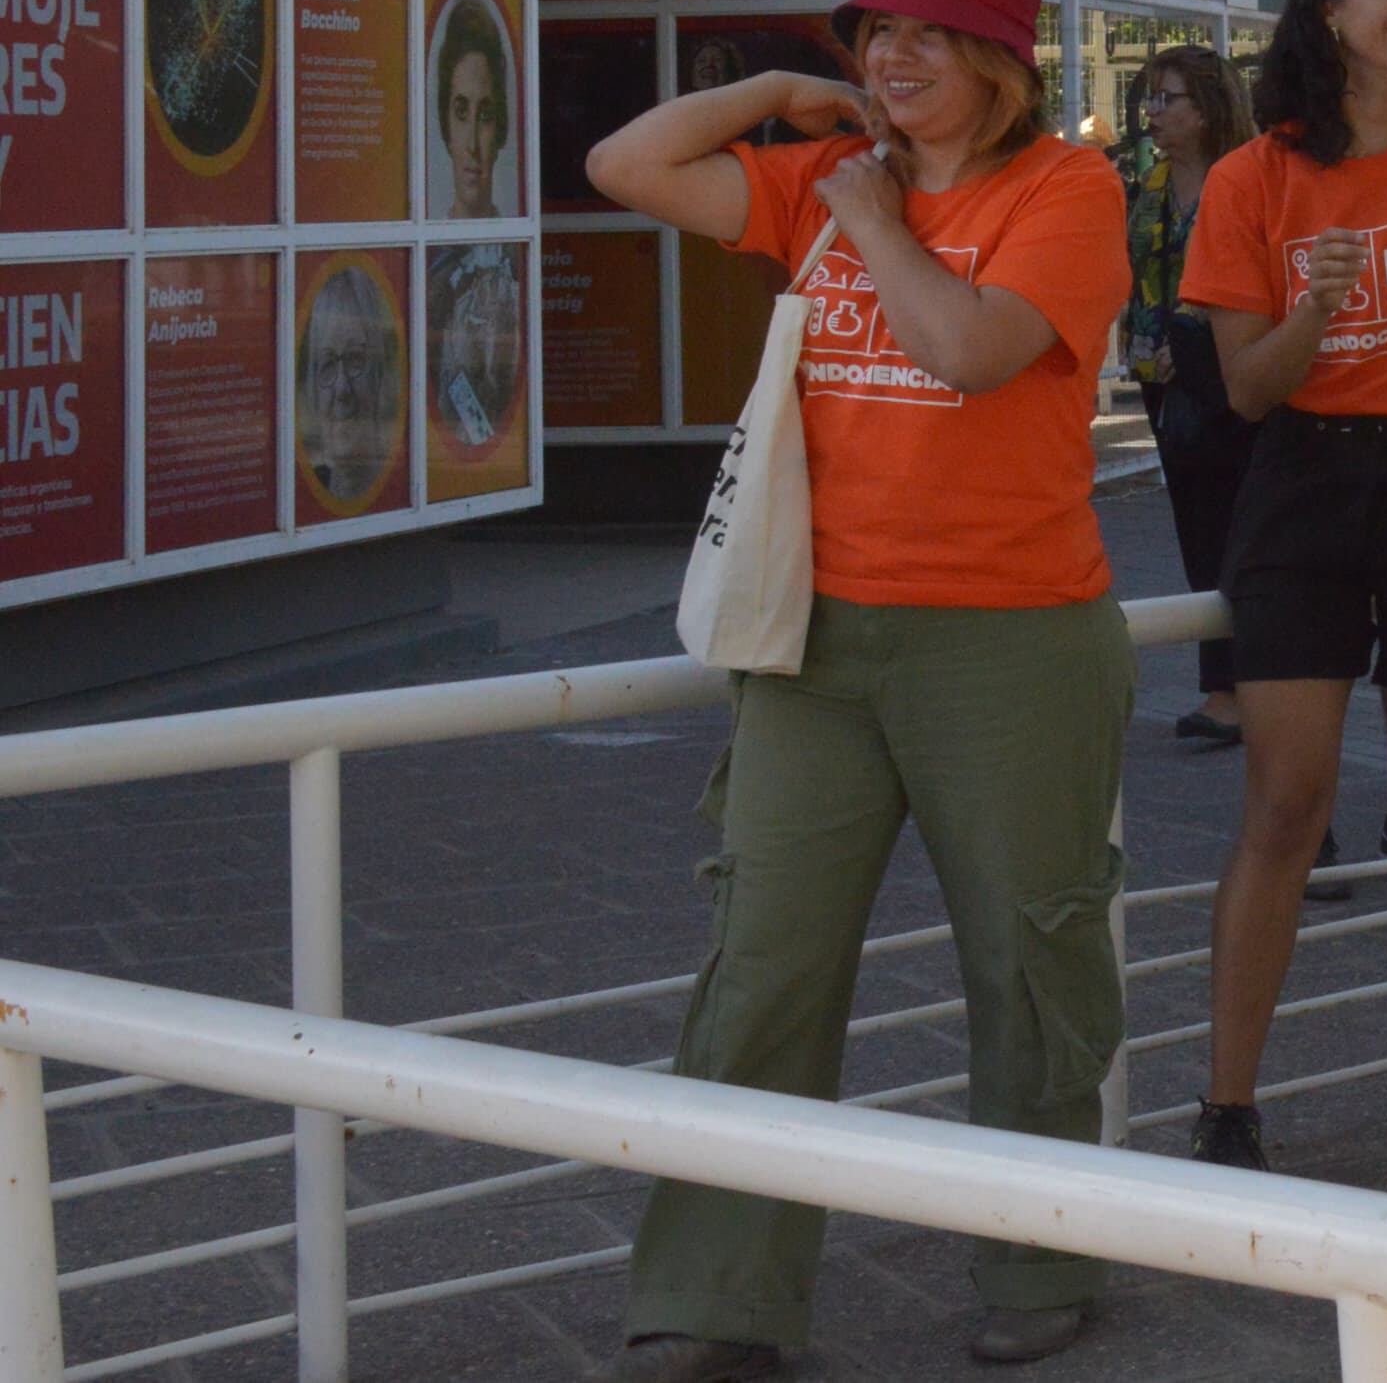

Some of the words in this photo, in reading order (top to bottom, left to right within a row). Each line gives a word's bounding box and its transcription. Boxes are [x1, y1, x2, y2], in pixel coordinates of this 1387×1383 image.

[300, 9, 360, 32] Bocchino
[148, 286, 204, 309] Rebeca
[0, 291, 82, 371] IEN
[148, 314, 218, 346] Anijovich
[0, 382, 79, 464] IAS
